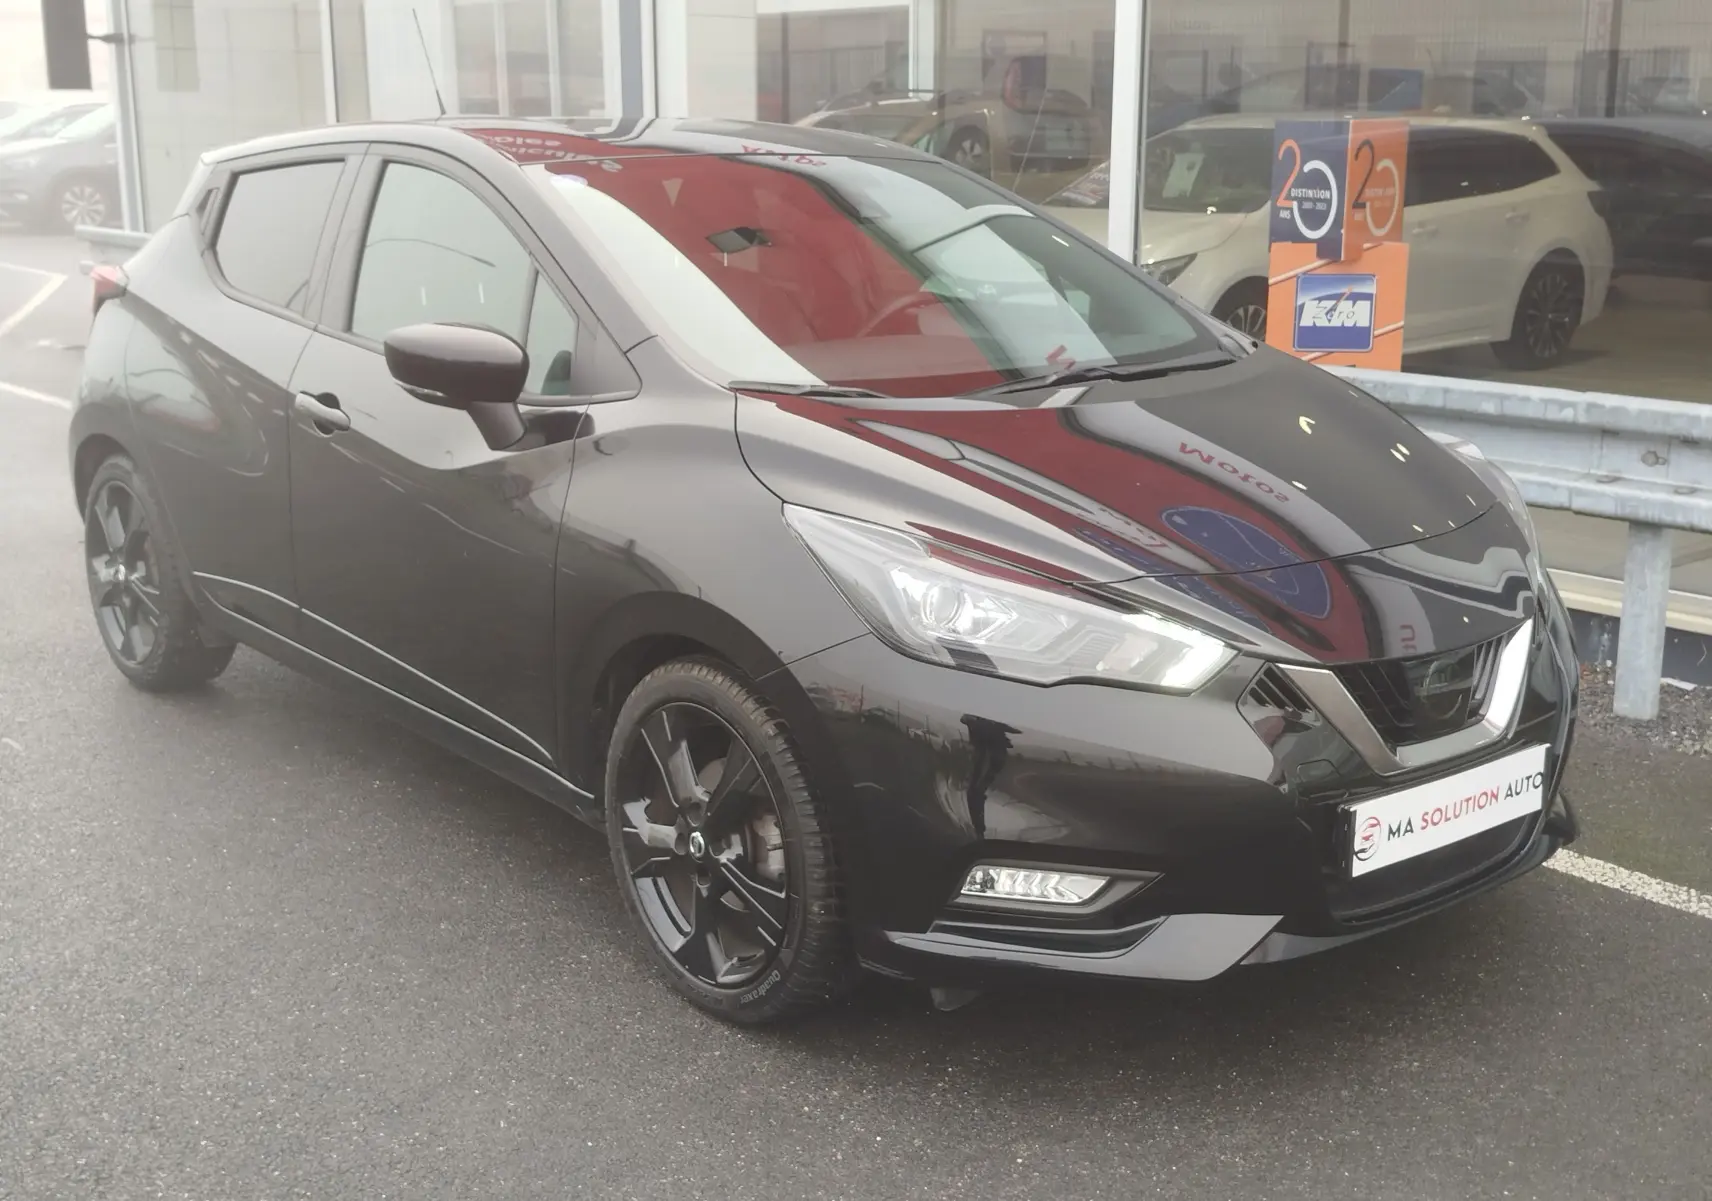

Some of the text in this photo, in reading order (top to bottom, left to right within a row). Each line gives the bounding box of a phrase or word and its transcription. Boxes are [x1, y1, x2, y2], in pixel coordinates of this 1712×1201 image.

[1387, 771, 1545, 841] MA SOLUTION AUTO
[740, 969, 781, 1004] Quadraxer
